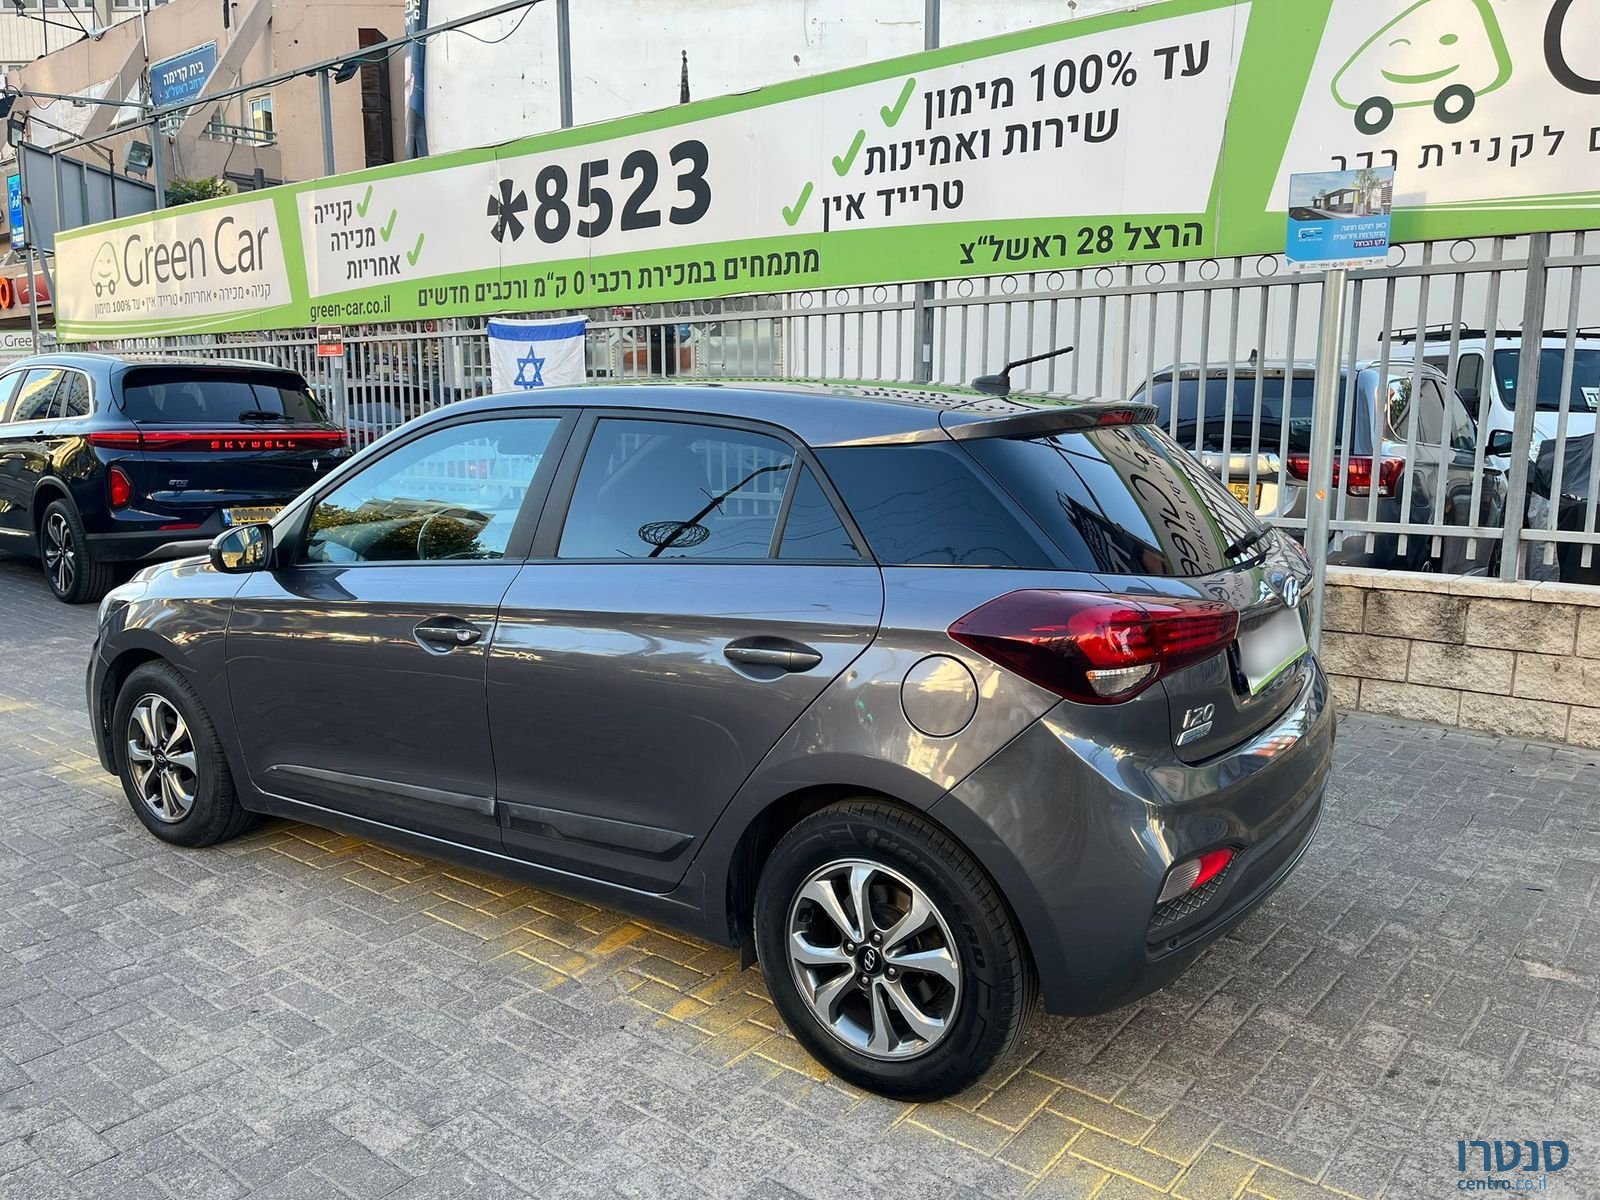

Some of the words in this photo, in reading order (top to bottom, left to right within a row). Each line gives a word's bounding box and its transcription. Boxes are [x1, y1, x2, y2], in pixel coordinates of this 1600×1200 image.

[189, 62, 204, 76] בית
[1153, 39, 1210, 80] עד
[163, 66, 187, 86] קדימה
[1029, 49, 1137, 102] 100%
[924, 78, 1014, 130] מימון
[1002, 107, 1120, 156] שירות
[864, 128, 990, 176] ואמינות
[1417, 125, 1565, 168] לקניית
[876, 178, 965, 216] טרייד
[314, 200, 352, 226] קנייה
[822, 192, 866, 233] אין
[331, 227, 376, 251] מכירה
[960, 233, 1067, 265] ראשל"צ
[1077, 225, 1114, 255] 28
[1124, 221, 1203, 251] הרצל
[124, 234, 207, 287] Green
[214, 216, 269, 275] Car
[724, 249, 819, 280] מתמחים
[347, 254, 400, 280] אחריות
[638, 261, 716, 289] במכירת
[219, 286, 244, 301] מכירה
[251, 283, 271, 301] קניה
[475, 280, 528, 302] ורכבים
[534, 272, 567, 298] ק"מ
[574, 270, 585, 295] 0
[591, 270, 631, 293] רכבי
[112, 300, 131, 313] 100%
[158, 293, 178, 308] טרייד
[184, 289, 212, 305] אחריות
[310, 295, 391, 322] green-car.co.il
[418, 285, 470, 307] חדשים
[94, 302, 111, 318] מימון
[5, 335, 32, 347] Gree
[211, 440, 296, 448] SKYWELL
